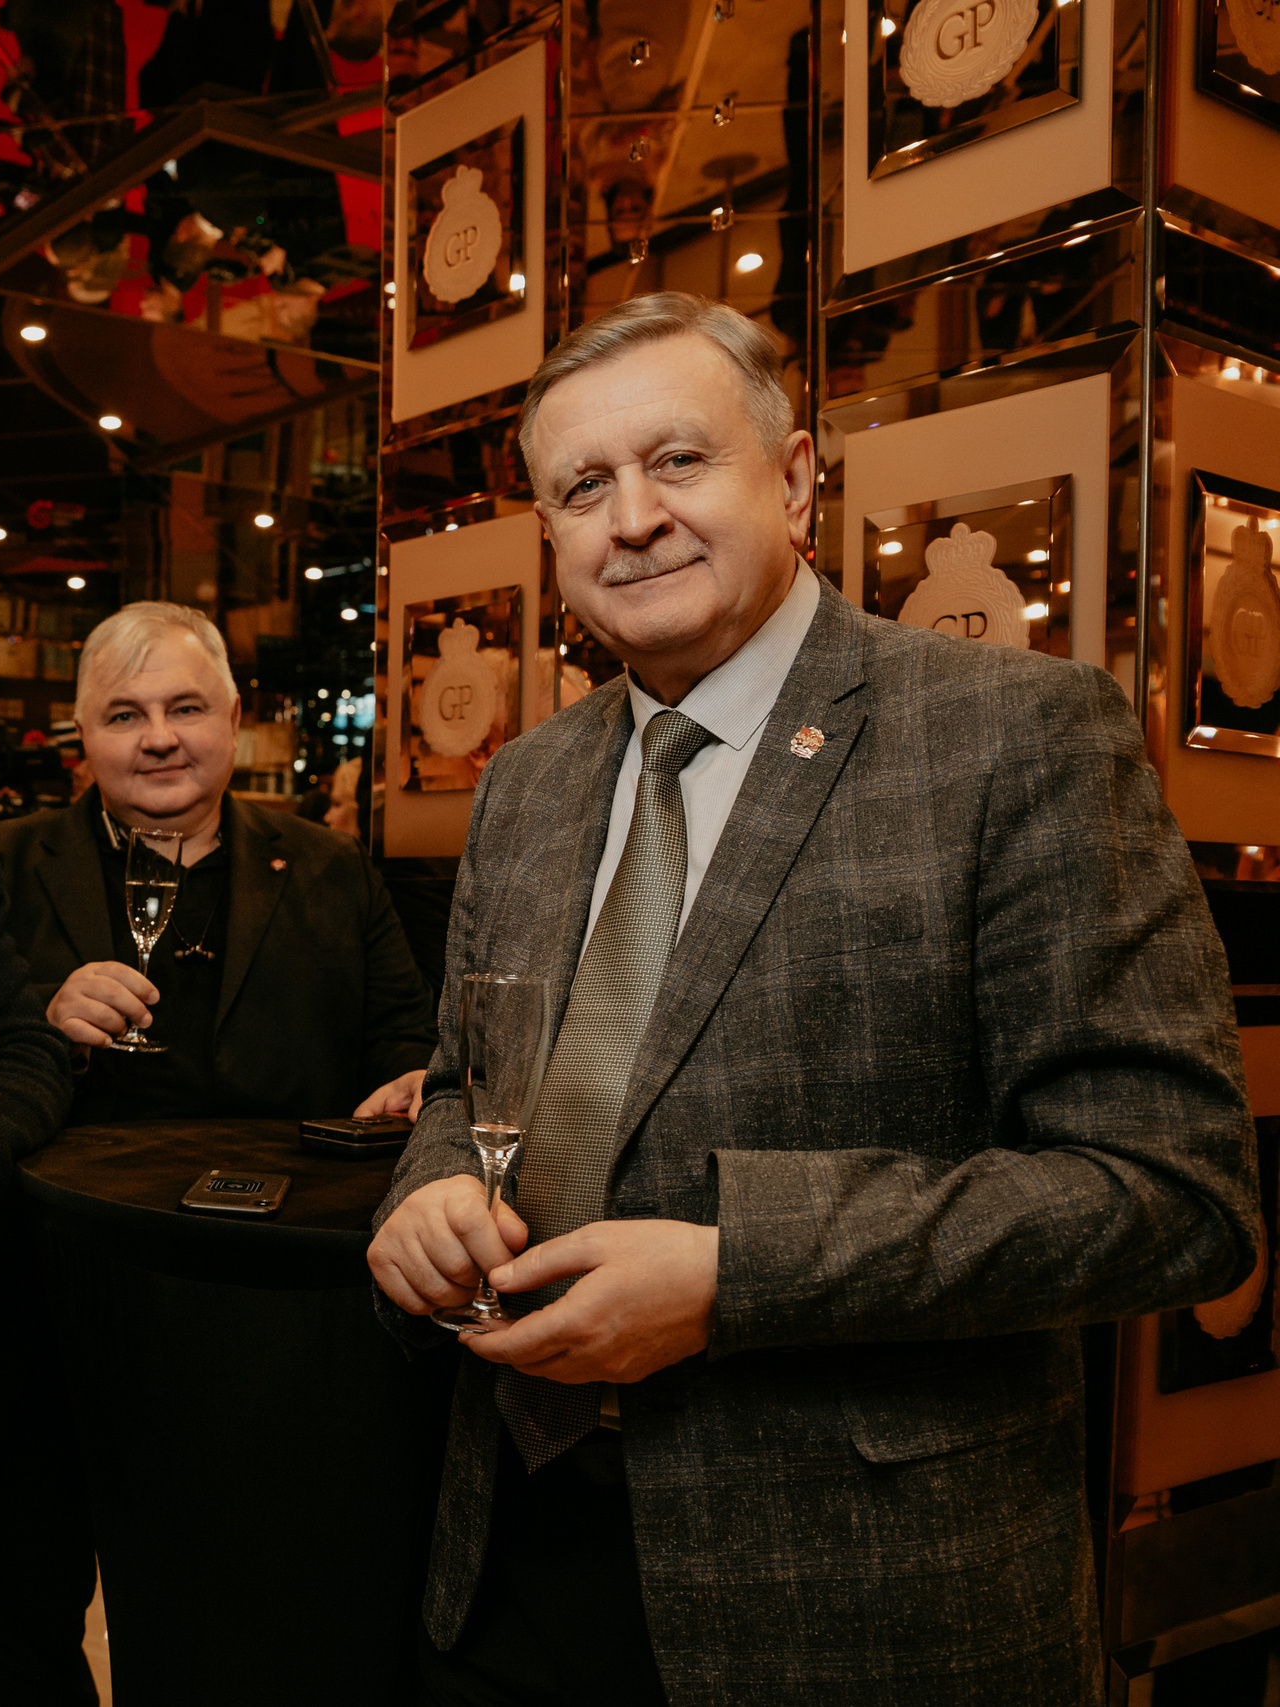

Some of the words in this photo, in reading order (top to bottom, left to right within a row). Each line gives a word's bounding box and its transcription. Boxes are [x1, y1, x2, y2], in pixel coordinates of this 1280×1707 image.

[936, 0, 995, 60] GP
[443, 225, 478, 268] GP
[438, 684, 473, 721] GP
